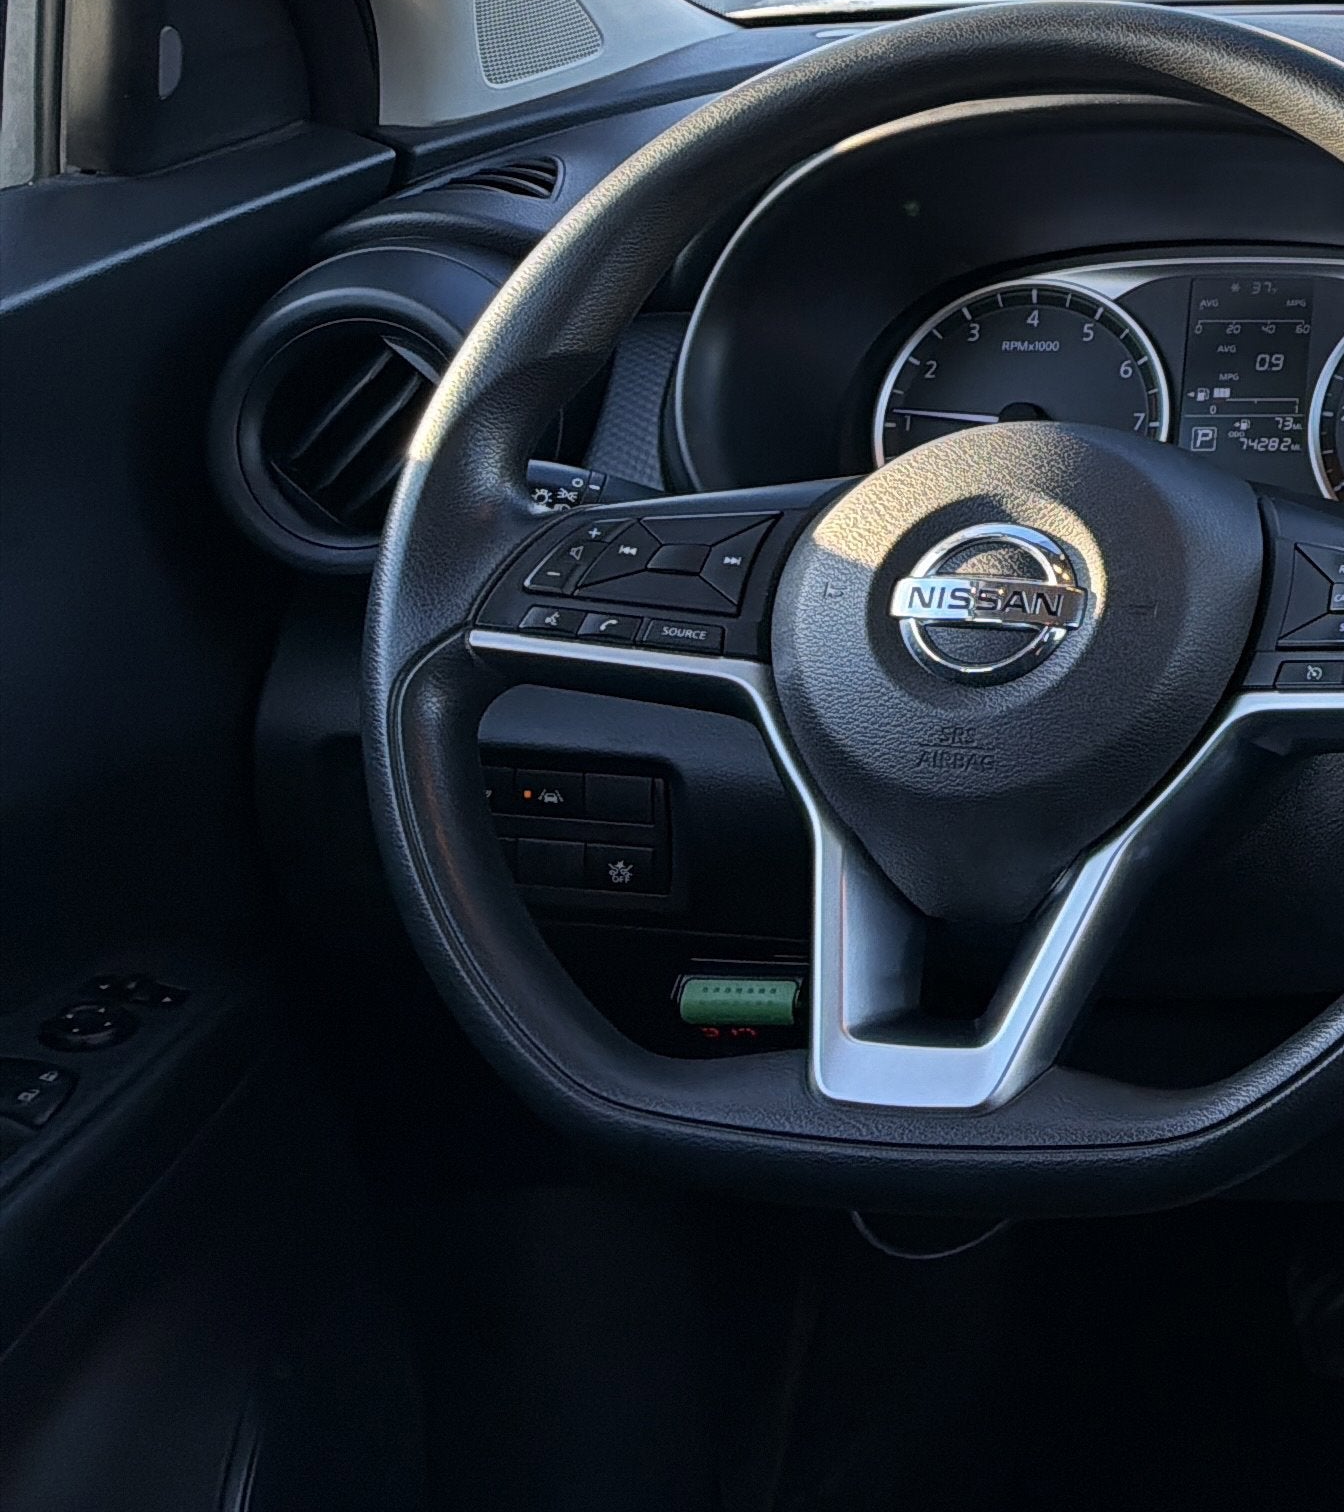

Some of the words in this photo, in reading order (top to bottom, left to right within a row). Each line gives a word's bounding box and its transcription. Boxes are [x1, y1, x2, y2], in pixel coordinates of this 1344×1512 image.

[1026, 309, 1040, 327] 4
[967, 323, 980, 342] 3
[1082, 323, 1095, 342] 5
[1226, 324, 1241, 335] 20
[1261, 324, 1276, 334] 40
[1295, 324, 1311, 334] 60
[1001, 340, 1060, 352] RPMx1000
[1217, 344, 1237, 353] AVG
[924, 360, 938, 379] 2
[1119, 360, 1133, 378] 6
[1218, 373, 1240, 381] MPG
[904, 415, 912, 431] 1
[1133, 413, 1145, 431] 7
[1195, 429, 1213, 448] P
[1239, 437, 1292, 452] 74282
[907, 586, 1064, 617] NISSAN
[662, 626, 707, 640] SOURCE
[940, 727, 977, 744] SRS
[916, 750, 996, 771] AIRBAG
[611, 875, 632, 885] OFF
